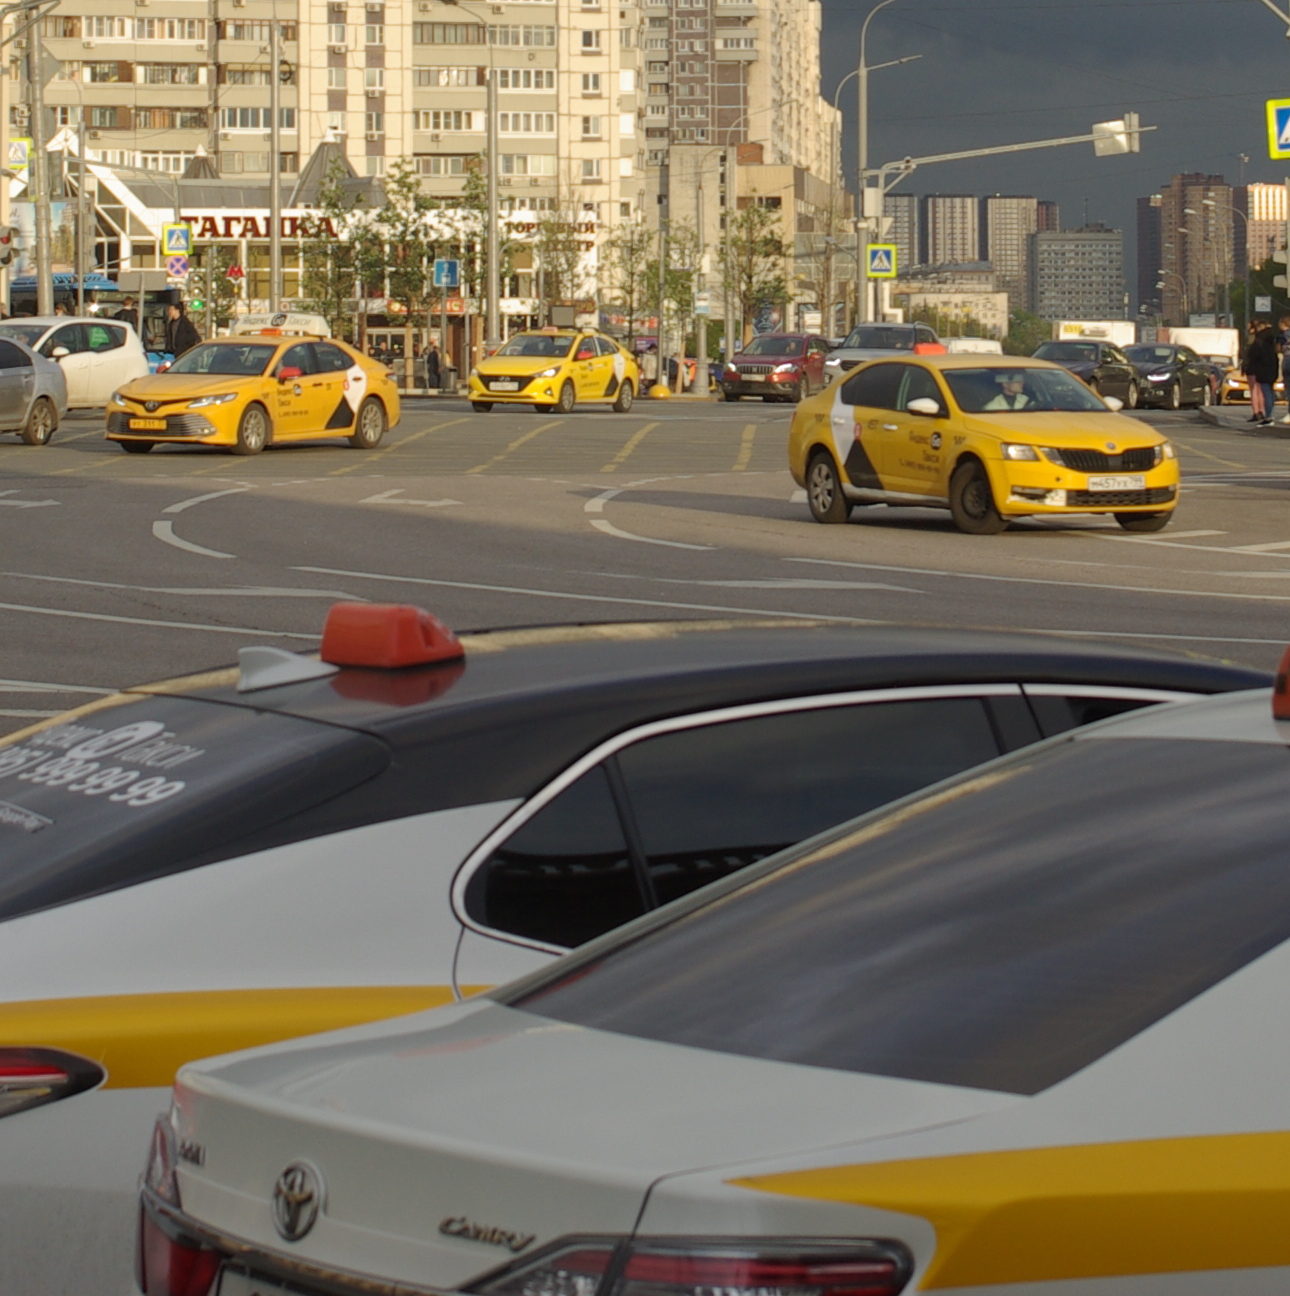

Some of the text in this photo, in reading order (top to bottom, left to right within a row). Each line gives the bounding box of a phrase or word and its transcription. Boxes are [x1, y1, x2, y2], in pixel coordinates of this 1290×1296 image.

[504, 221, 595, 234] ТОРГВЫЙ
[17, 754, 100, 786] 999
[67, 766, 141, 795] 99
[108, 775, 186, 806] 99
